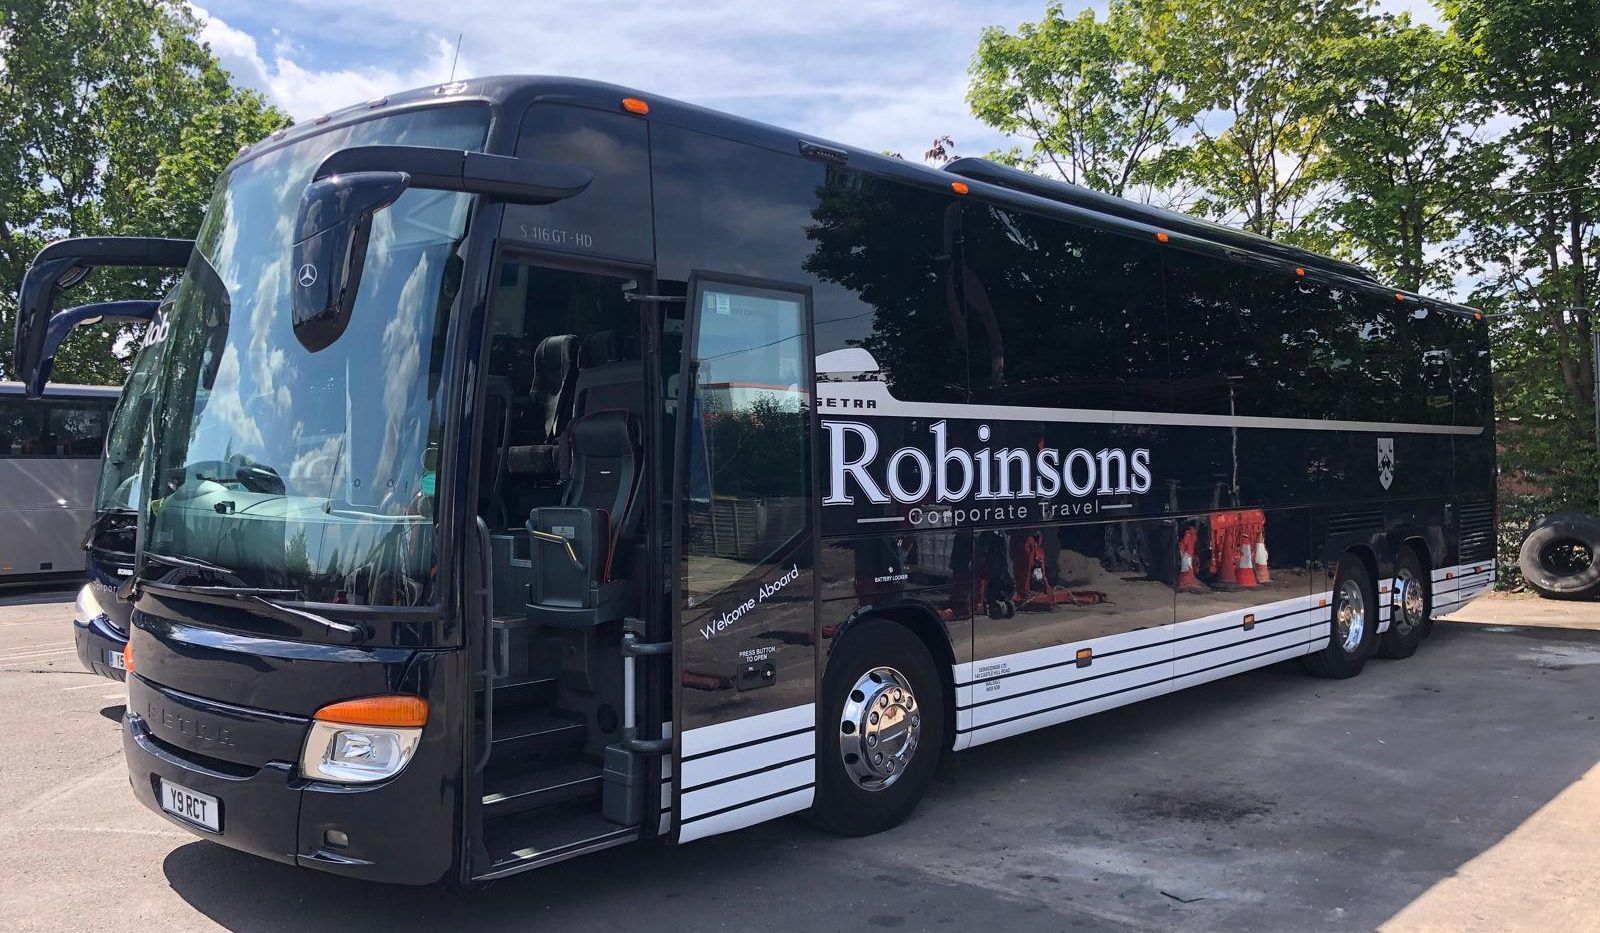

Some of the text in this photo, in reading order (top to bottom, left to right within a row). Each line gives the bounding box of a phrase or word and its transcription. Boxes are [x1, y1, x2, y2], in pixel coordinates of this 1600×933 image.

[821, 419, 1152, 506] Robinsons
[908, 499, 1099, 526] Corporate Travel
[700, 563, 799, 641] Welcome Aboard
[738, 646, 776, 658] PRESS BUTTON
[754, 654, 768, 662] OPEN
[170, 787, 207, 822] Y9 RCT
